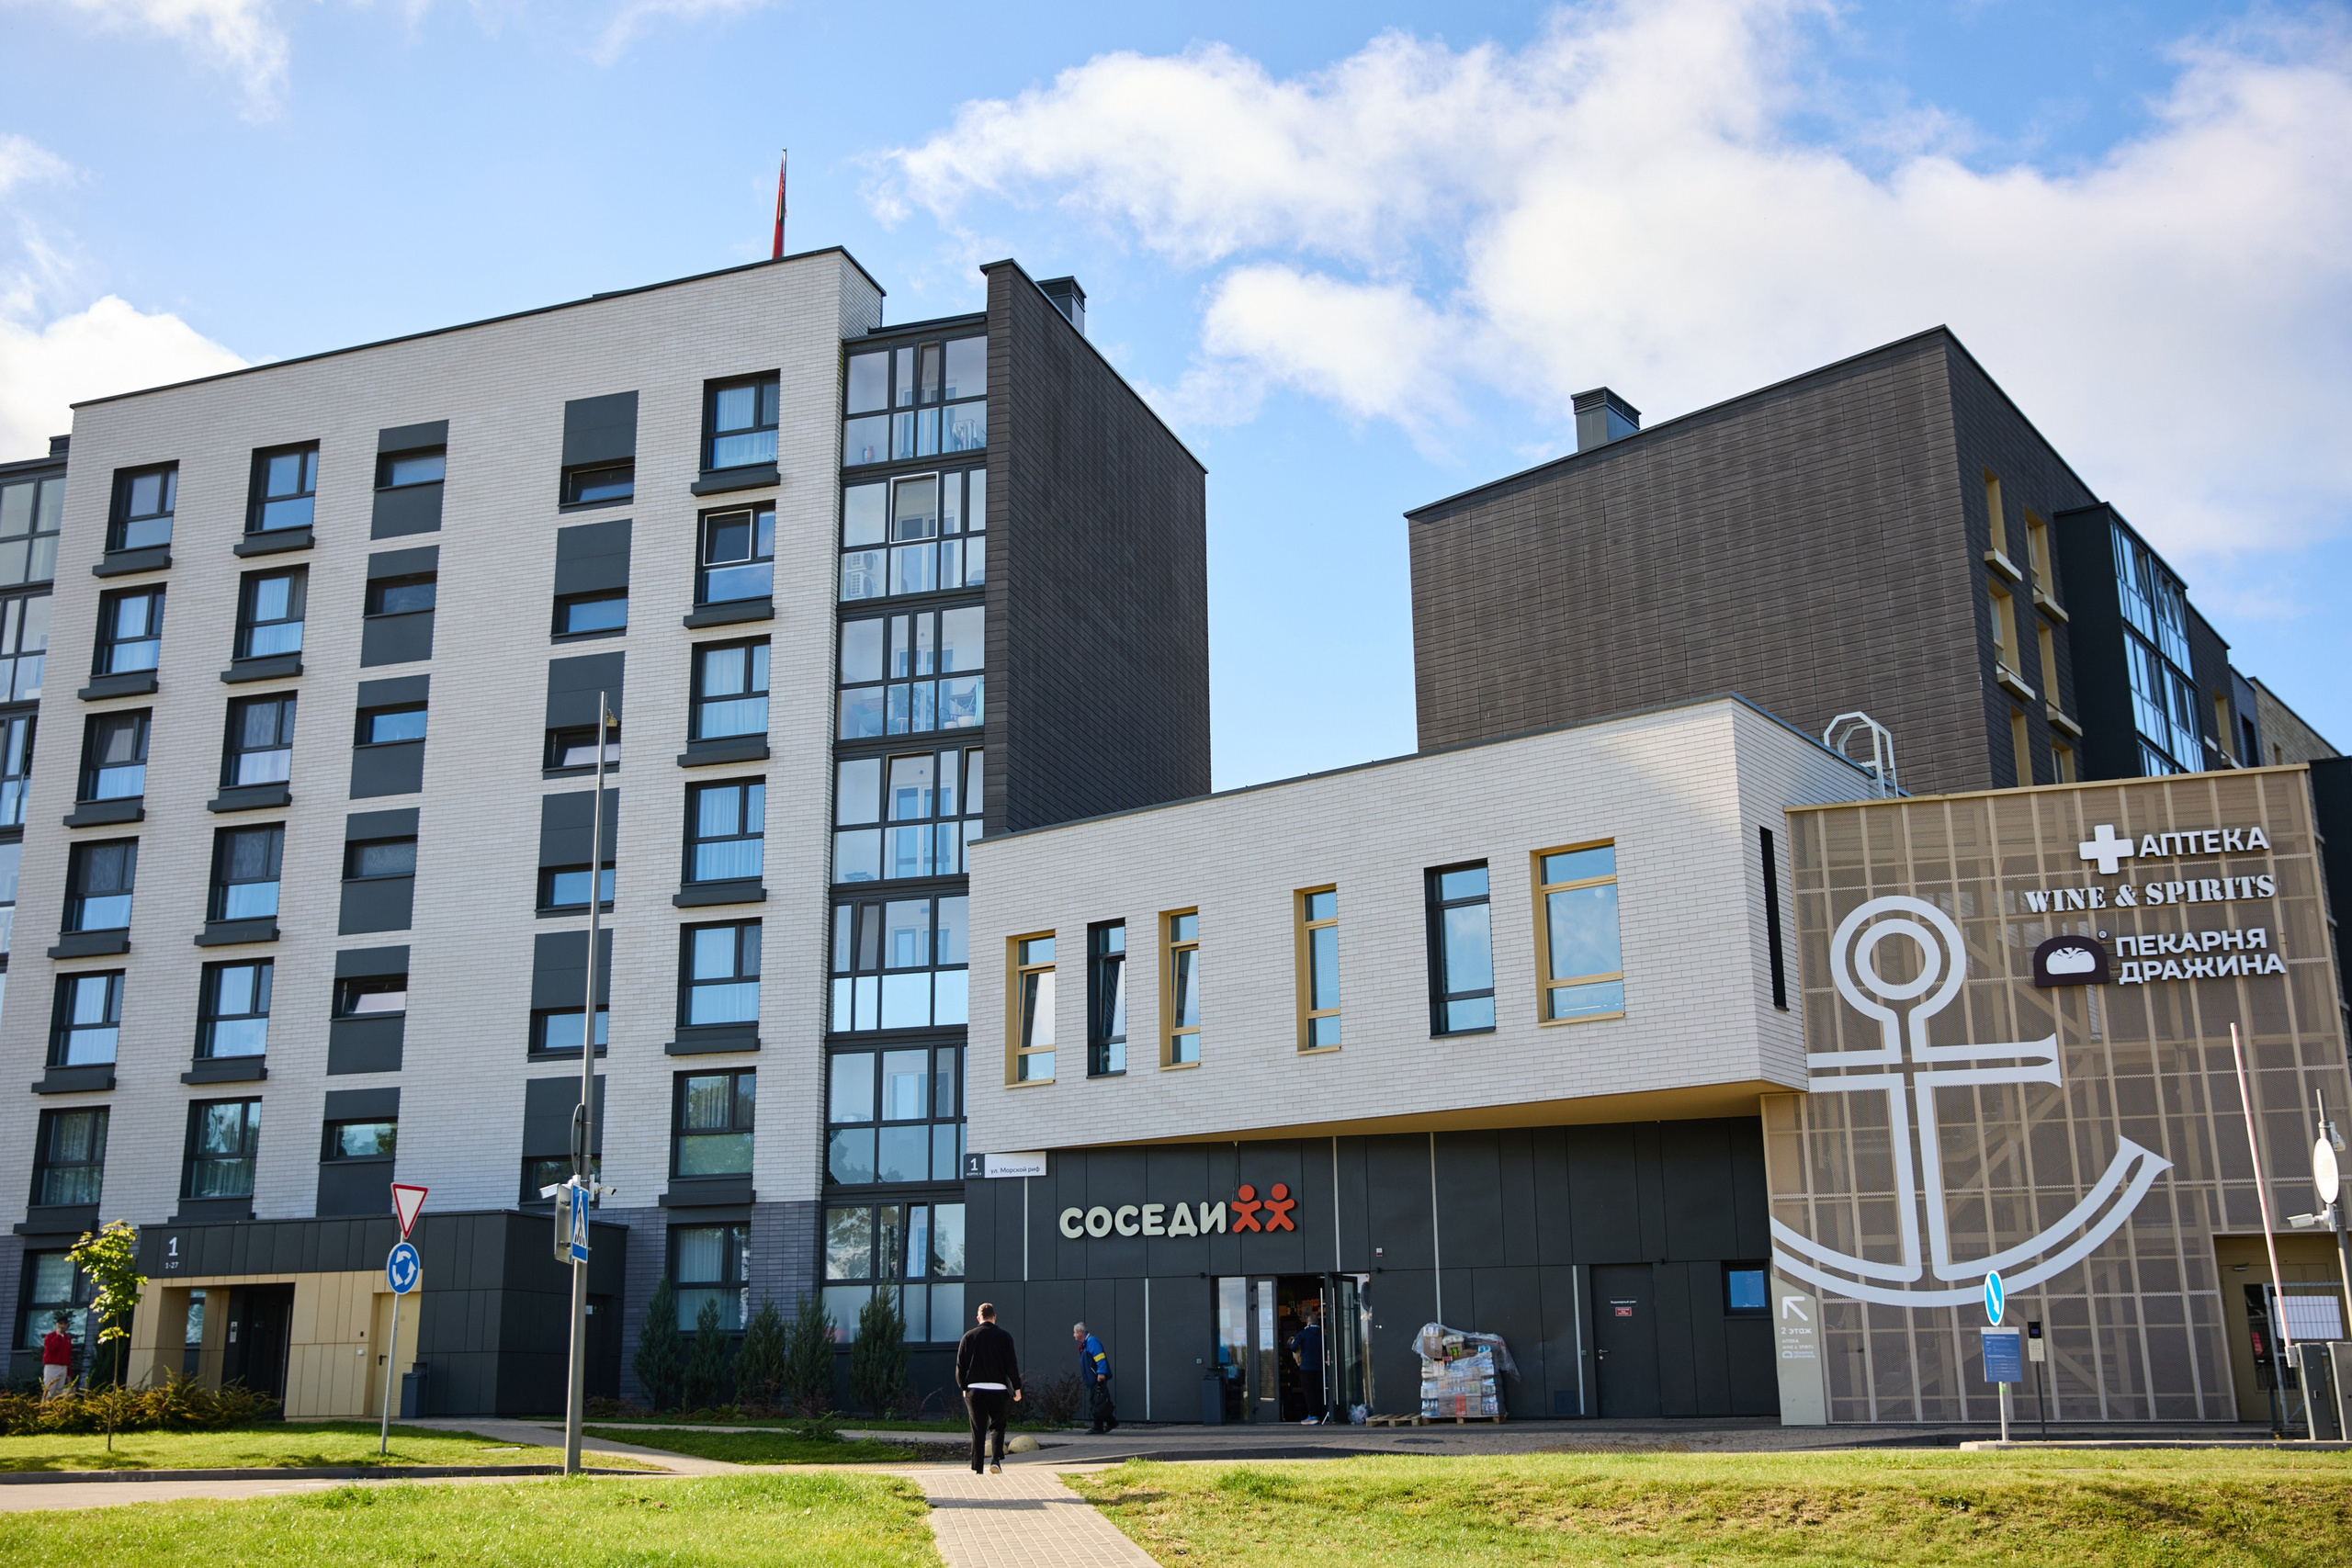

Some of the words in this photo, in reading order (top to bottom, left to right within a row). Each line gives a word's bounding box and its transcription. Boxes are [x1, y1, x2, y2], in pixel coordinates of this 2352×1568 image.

[2139, 827, 2270, 858] АПТЕКА
[2025, 886, 2107, 913] WINE
[2114, 884, 2139, 908] &
[2145, 874, 2276, 906] SPIRITS
[2115, 928, 2268, 957] ПЕКАРНЯ
[2118, 953, 2288, 986] ДРАЖИНА
[970, 1157, 978, 1171] 1
[1001, 1166, 1027, 1174] Морской
[1059, 1201, 1227, 1239] СОСЕДИ
[168, 1236, 178, 1257] 1
[1781, 1326, 1786, 1335] 2
